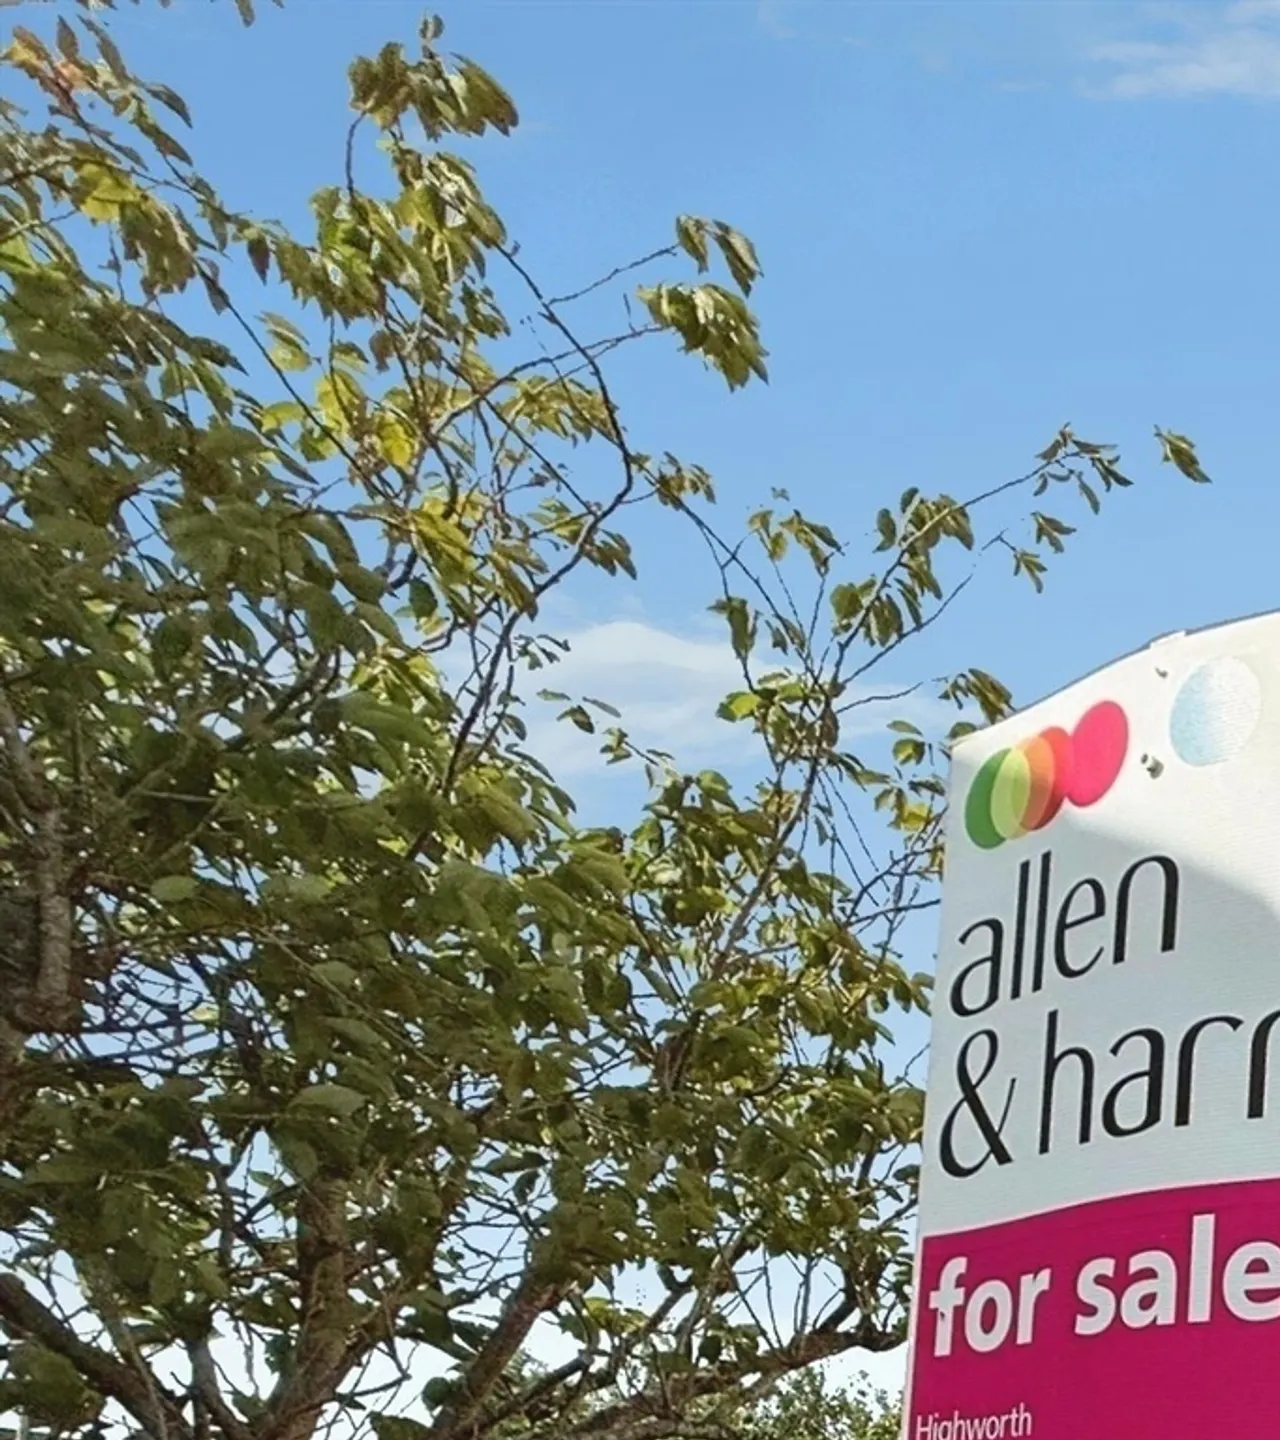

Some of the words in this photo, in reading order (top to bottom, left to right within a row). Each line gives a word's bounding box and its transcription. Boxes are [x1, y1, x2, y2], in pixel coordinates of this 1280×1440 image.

[950, 850, 1180, 1018] allen
[939, 1028, 1016, 1178] &
[929, 1256, 1051, 1357] for
